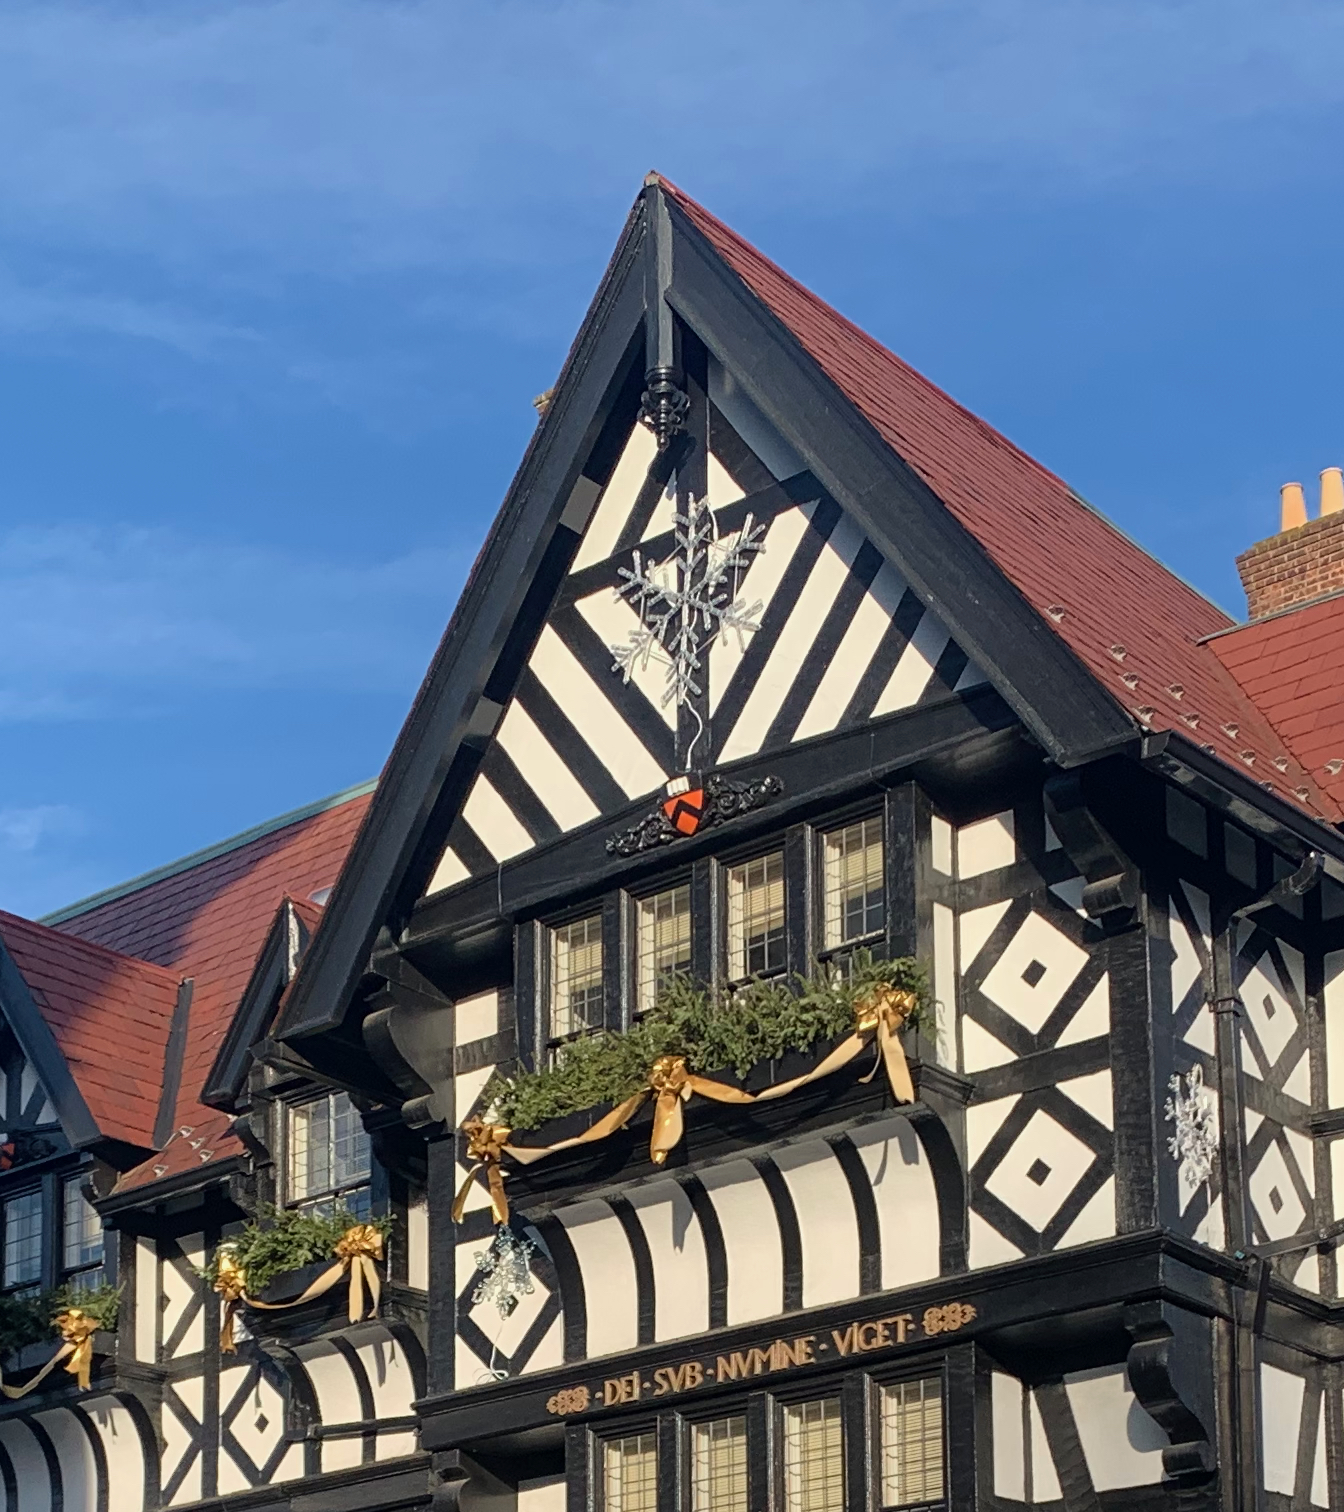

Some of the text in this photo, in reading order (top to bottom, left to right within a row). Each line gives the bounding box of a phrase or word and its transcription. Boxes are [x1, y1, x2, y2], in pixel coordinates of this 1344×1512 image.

[603, 1312, 913, 1406] DEI SVB NVMINE VIGET
